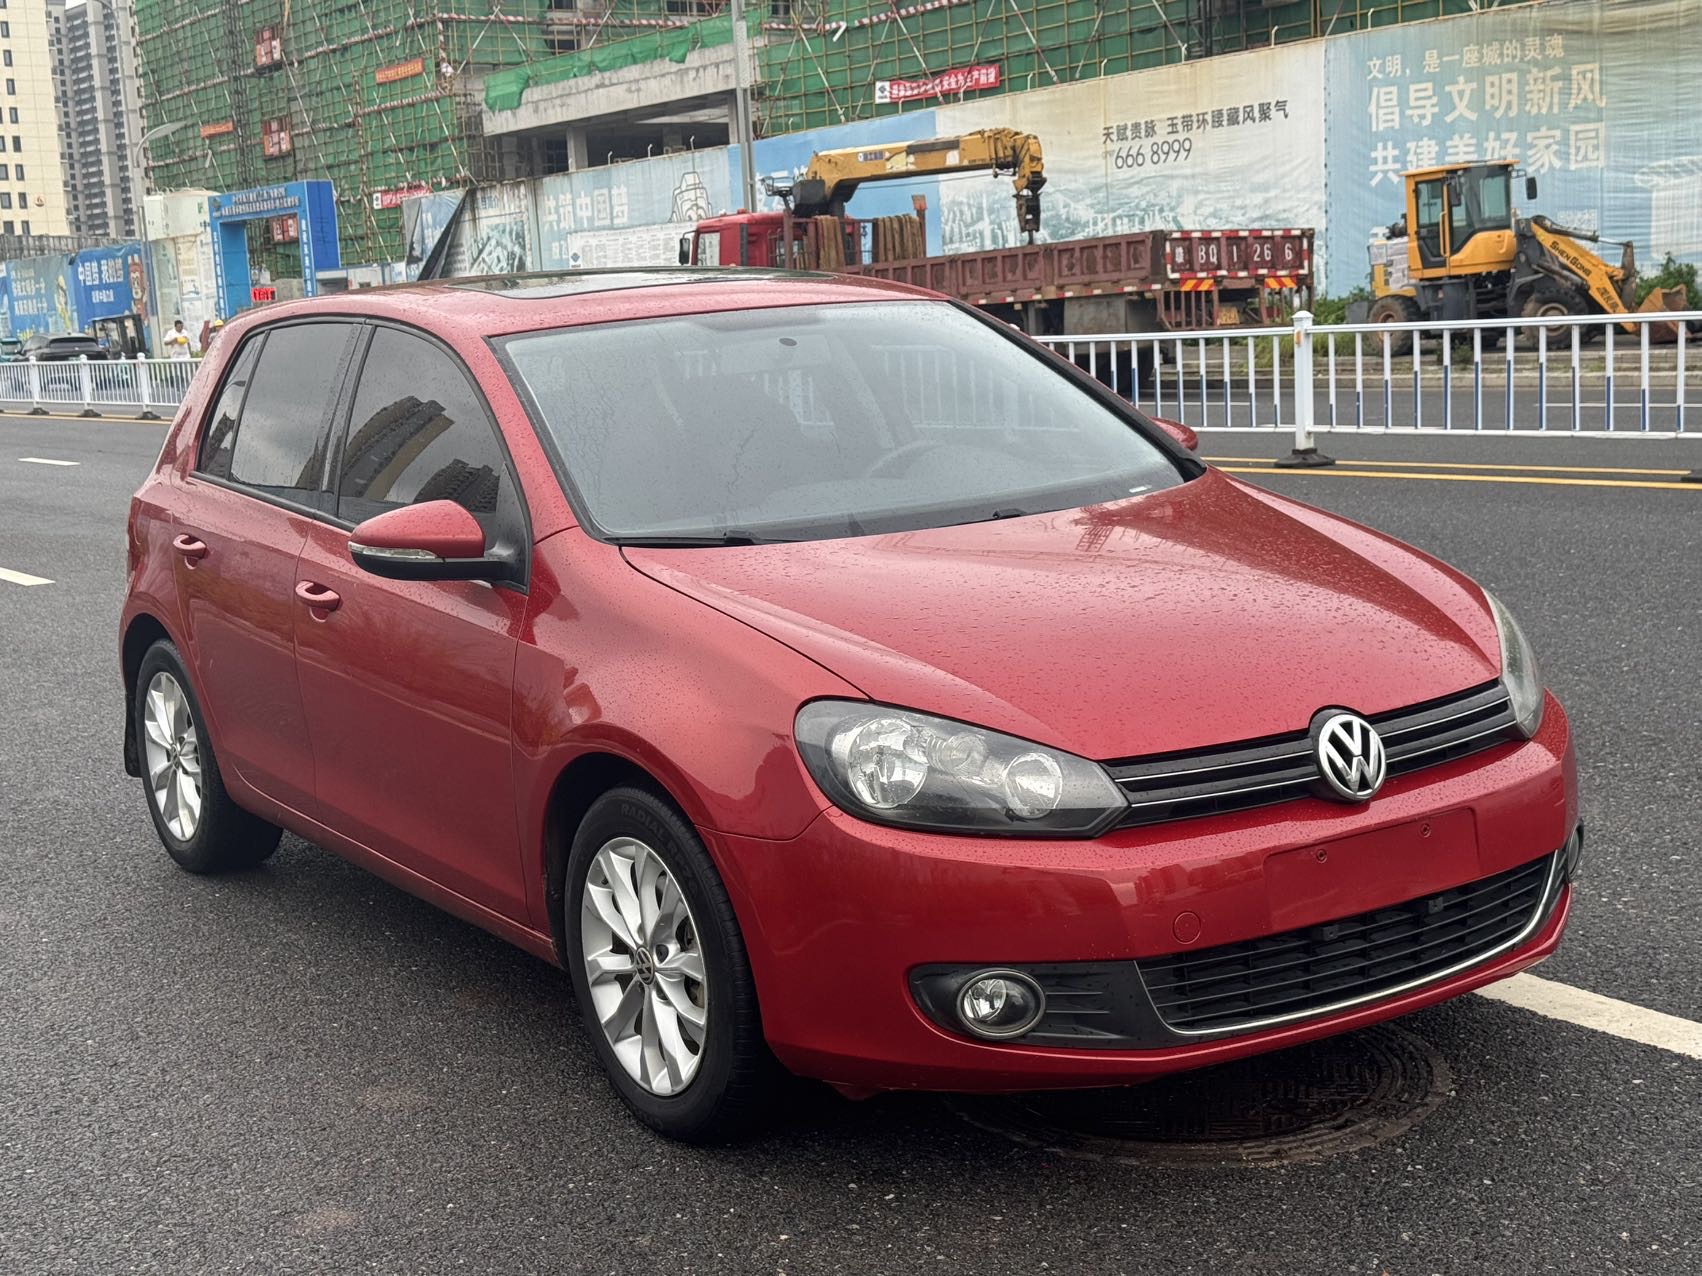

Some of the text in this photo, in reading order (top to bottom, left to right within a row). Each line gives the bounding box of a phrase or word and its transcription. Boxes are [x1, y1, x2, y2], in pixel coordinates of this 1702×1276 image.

[1102, 99, 1289, 144] 天赋贵脉 玉带环腰藏风聚气
[1367, 62, 1607, 132] 倡导文明新风
[1114, 137, 1193, 169] 666 8999
[1368, 121, 1606, 188] 共建美好家园
